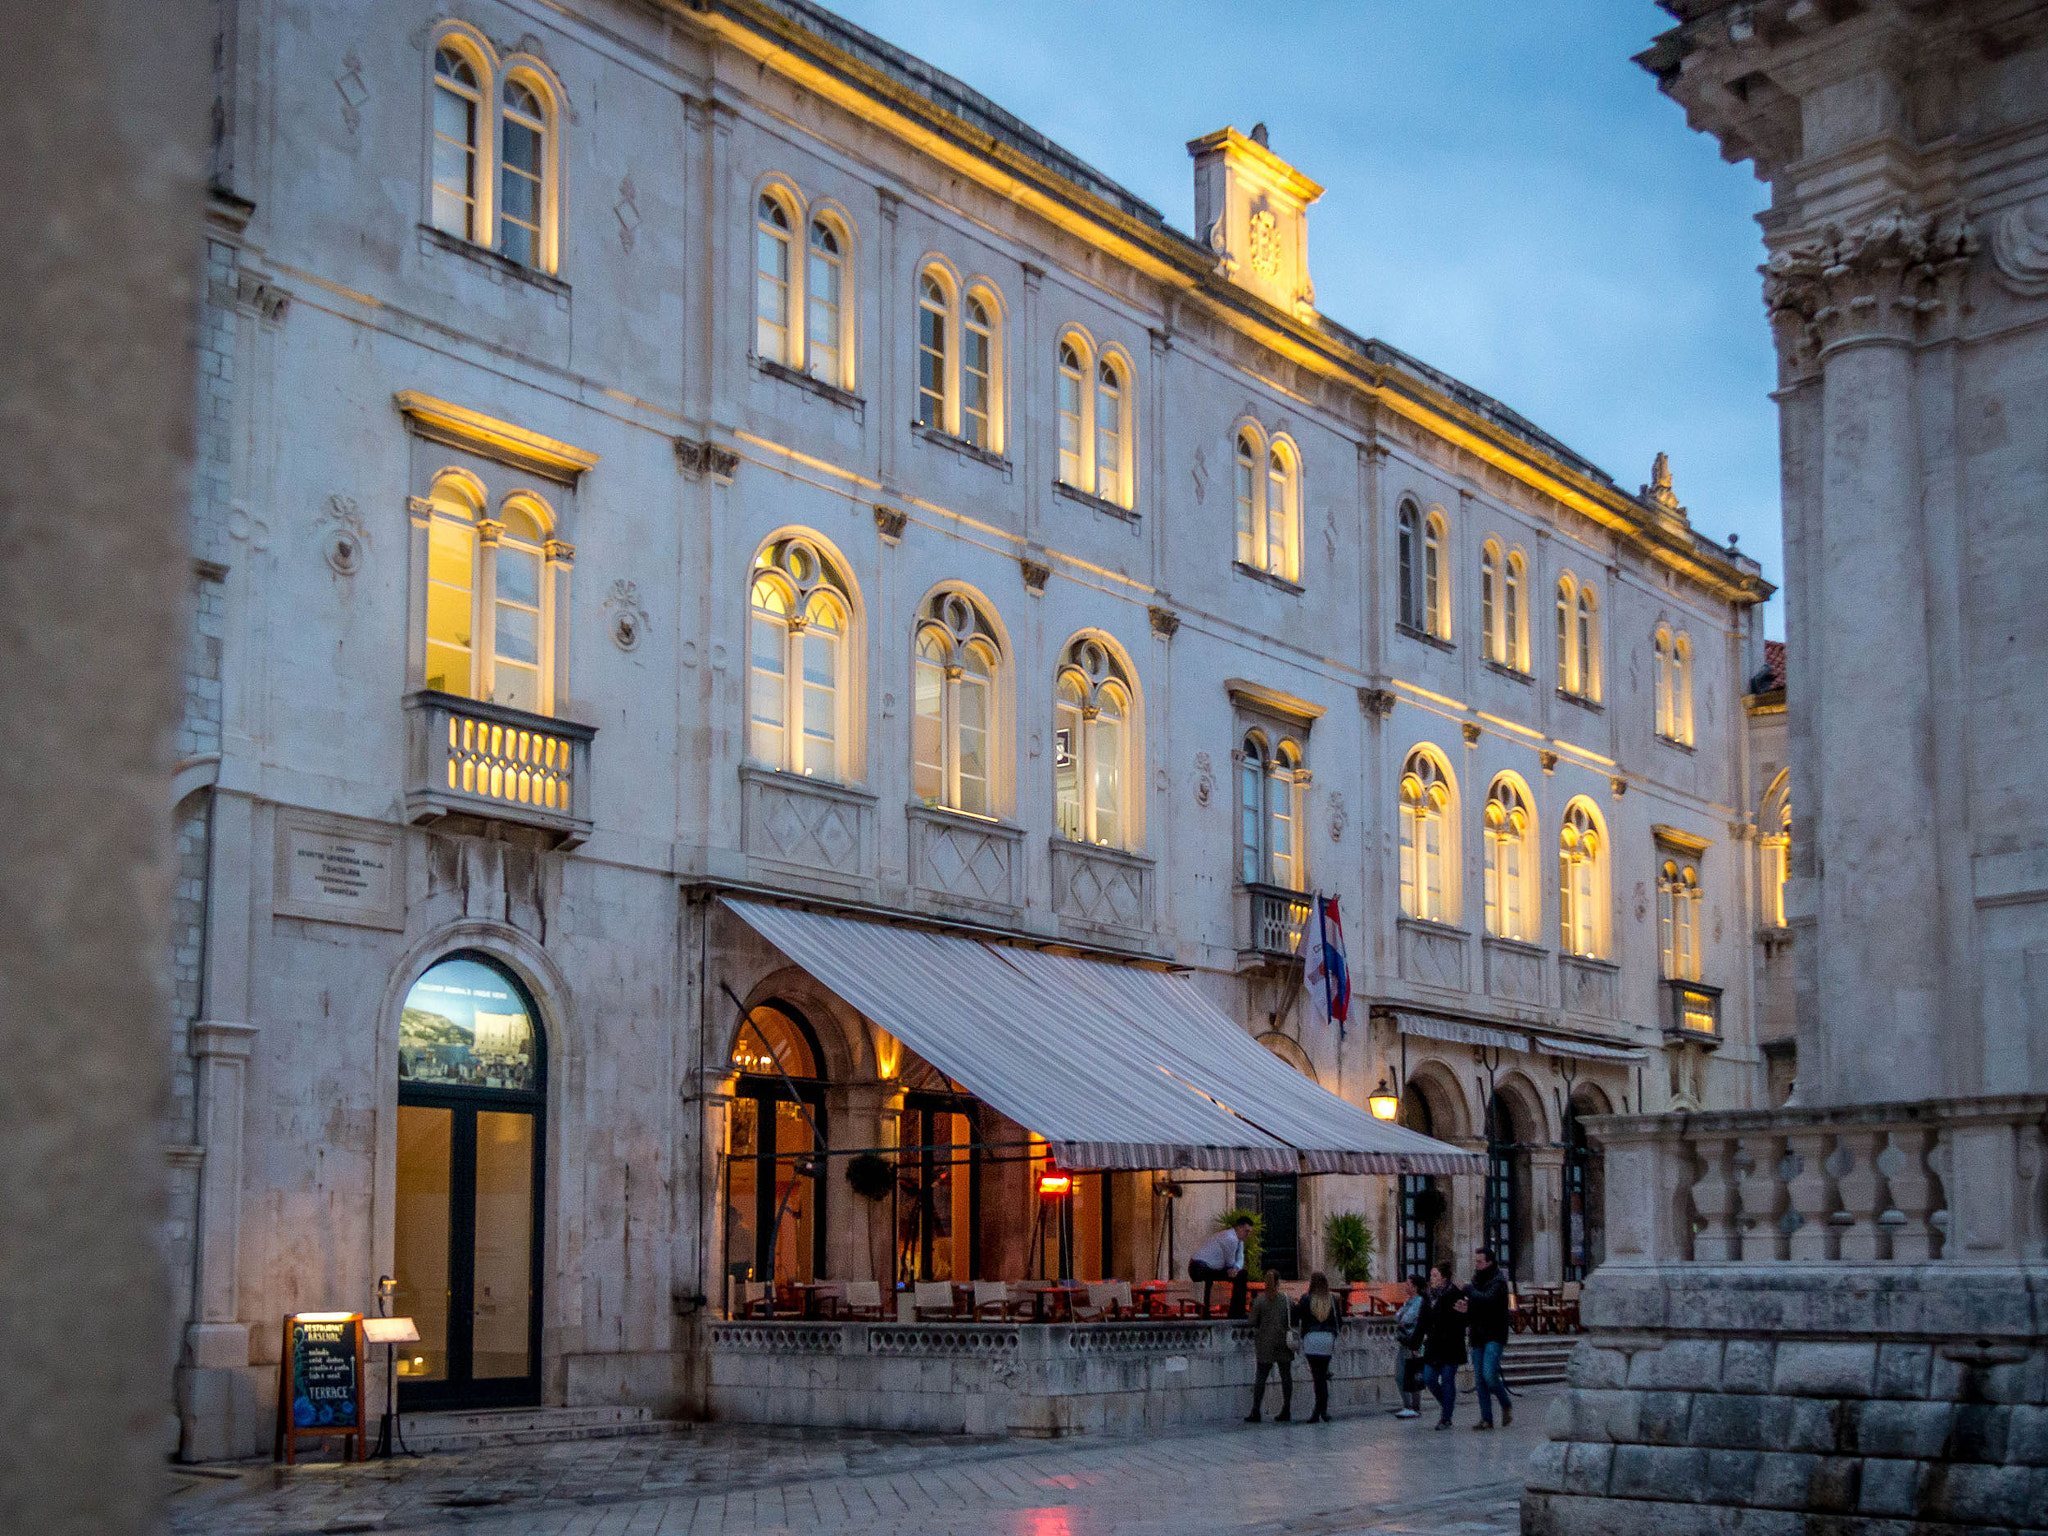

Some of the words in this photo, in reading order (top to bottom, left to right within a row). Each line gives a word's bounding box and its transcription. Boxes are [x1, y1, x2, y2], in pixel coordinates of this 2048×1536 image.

[304, 1324, 344, 1333] RESTAURANT
[308, 1332, 341, 1342] ARSENAL
[309, 1386, 348, 1399] TERRACE
